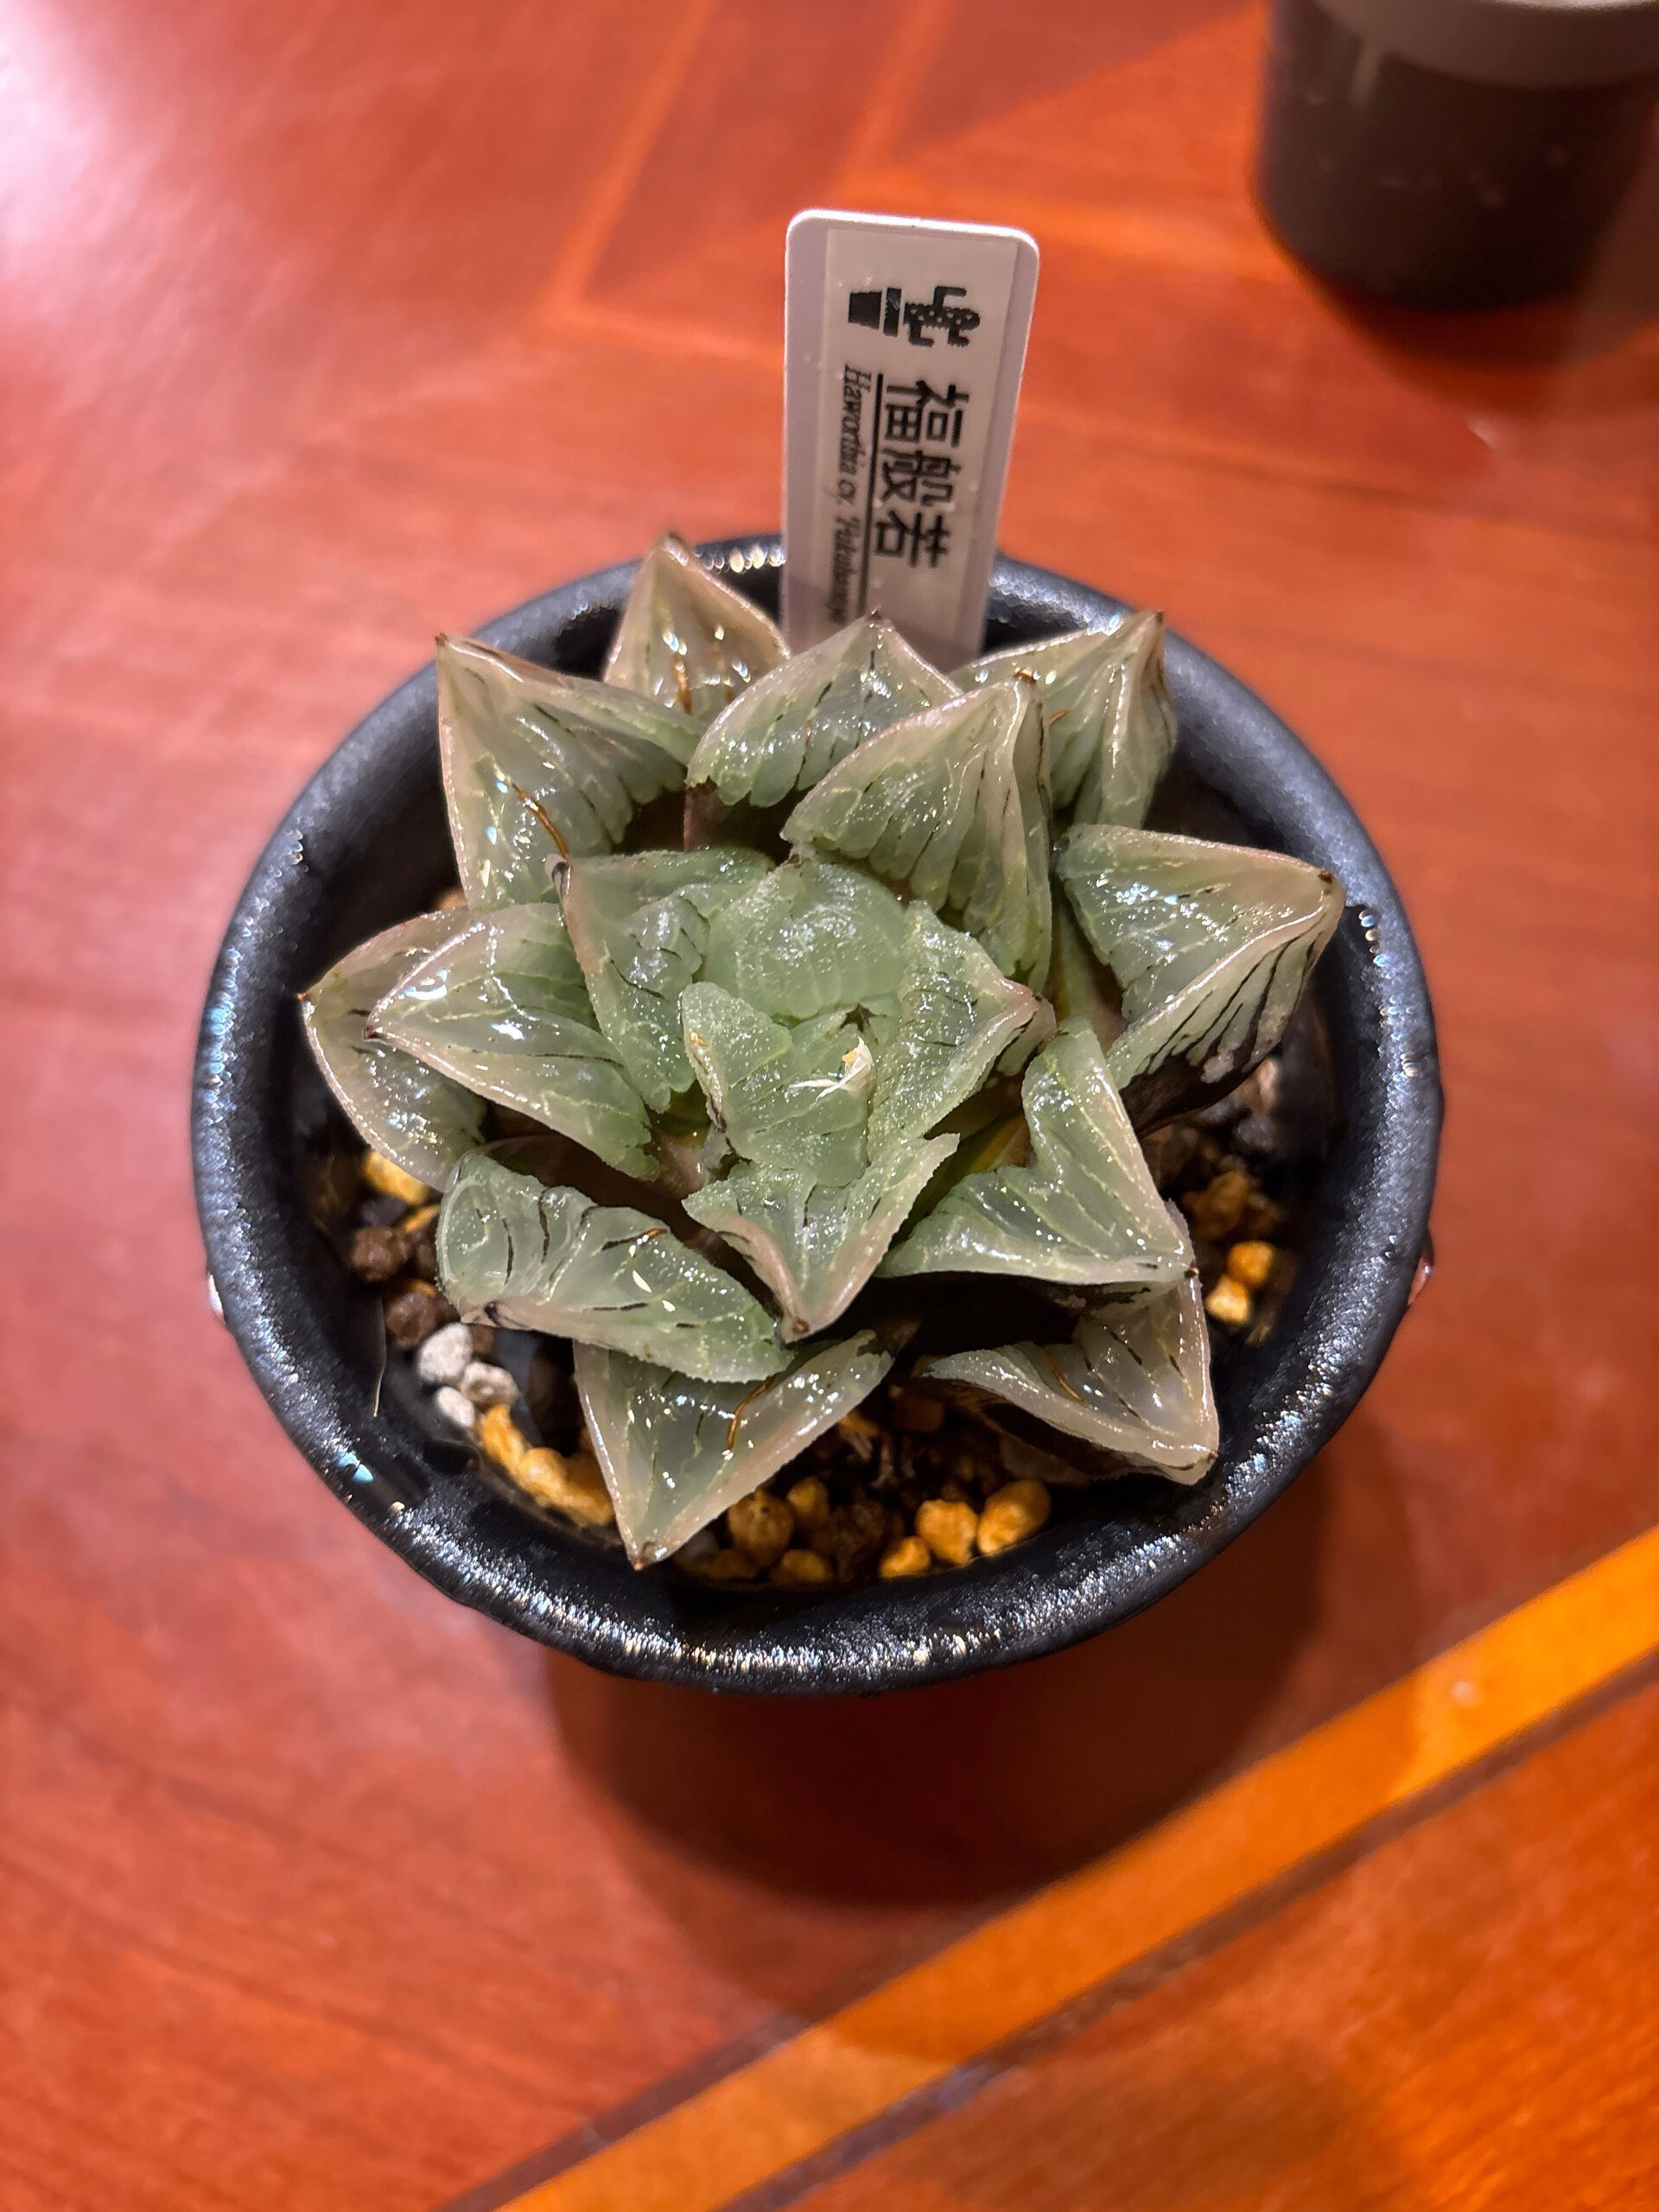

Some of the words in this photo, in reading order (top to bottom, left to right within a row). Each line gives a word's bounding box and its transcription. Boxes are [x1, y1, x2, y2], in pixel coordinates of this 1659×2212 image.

[839, 364, 871, 474] Haworthia
[874, 379, 969, 569] 福般若
